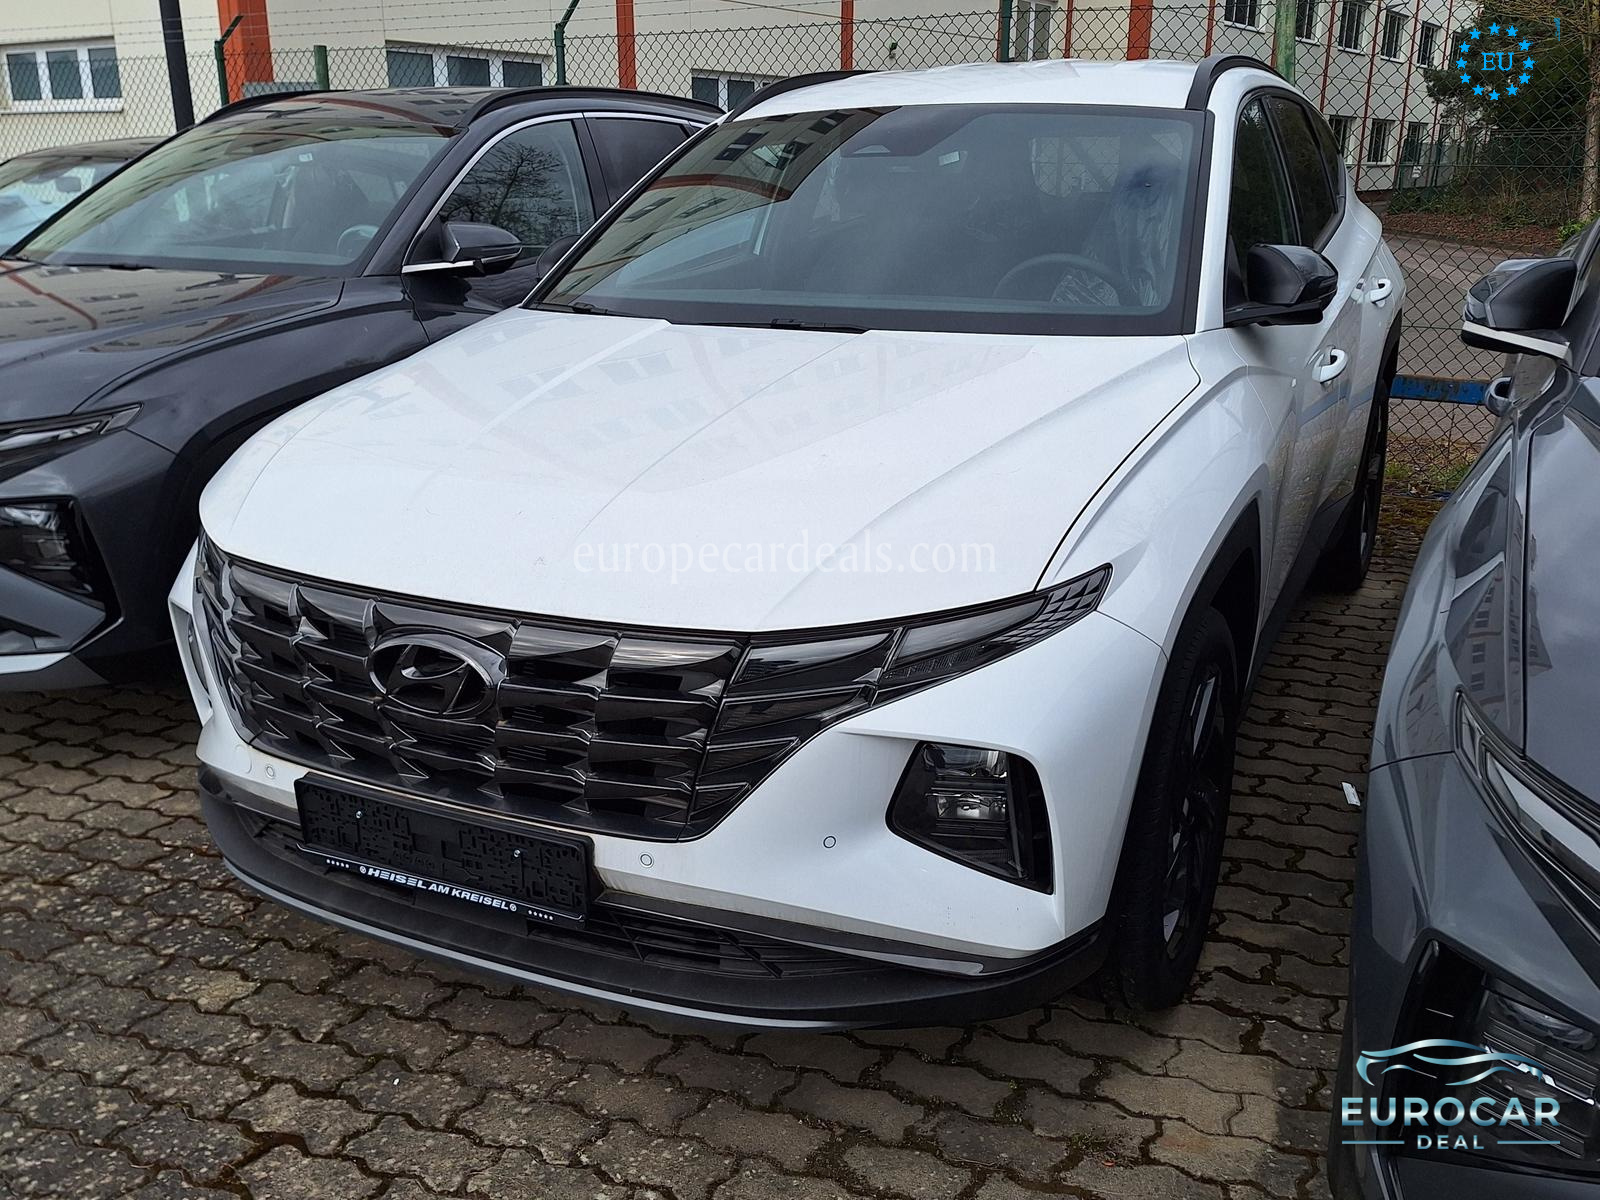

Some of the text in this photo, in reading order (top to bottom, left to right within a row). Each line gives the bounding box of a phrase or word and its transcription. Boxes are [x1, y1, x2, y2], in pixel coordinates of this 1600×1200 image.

[367, 867, 509, 910] HEISEL AM KREISEL
